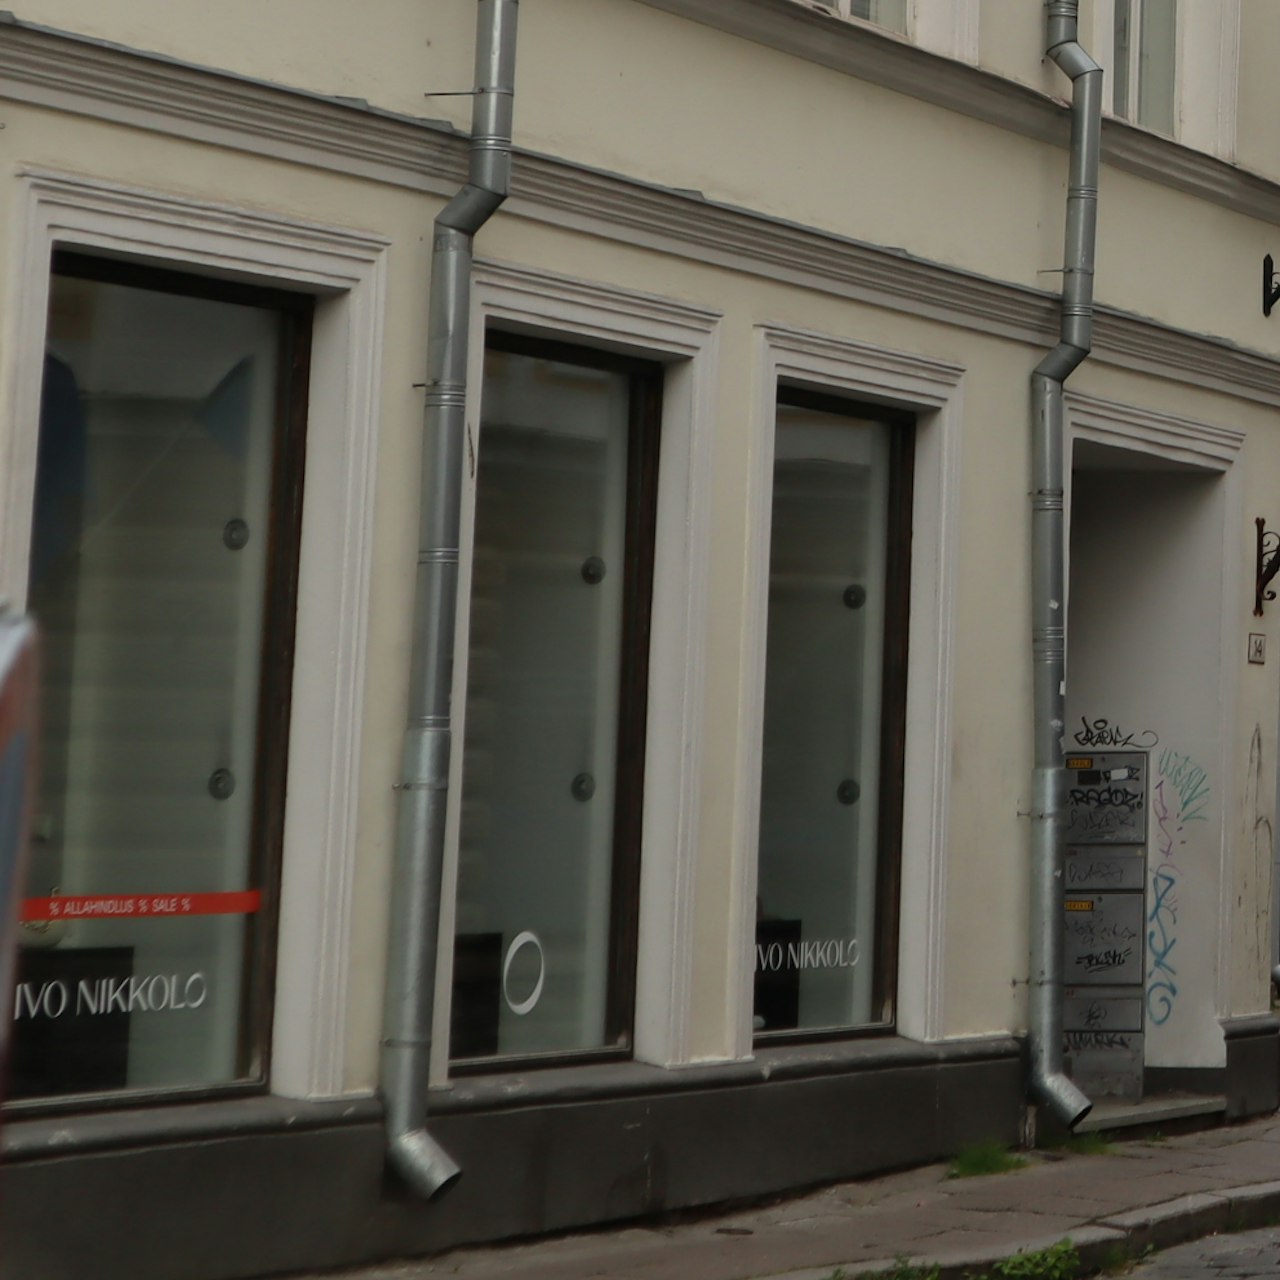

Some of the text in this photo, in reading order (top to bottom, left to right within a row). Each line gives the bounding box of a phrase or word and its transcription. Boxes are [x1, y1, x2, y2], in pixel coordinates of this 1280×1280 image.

[63, 899, 135, 915] ALLAHINDLUS
[152, 898, 177, 913] SALE
[787, 939, 860, 969] NIKKOLO
[14, 972, 208, 1020] IVO NIKKOLO
